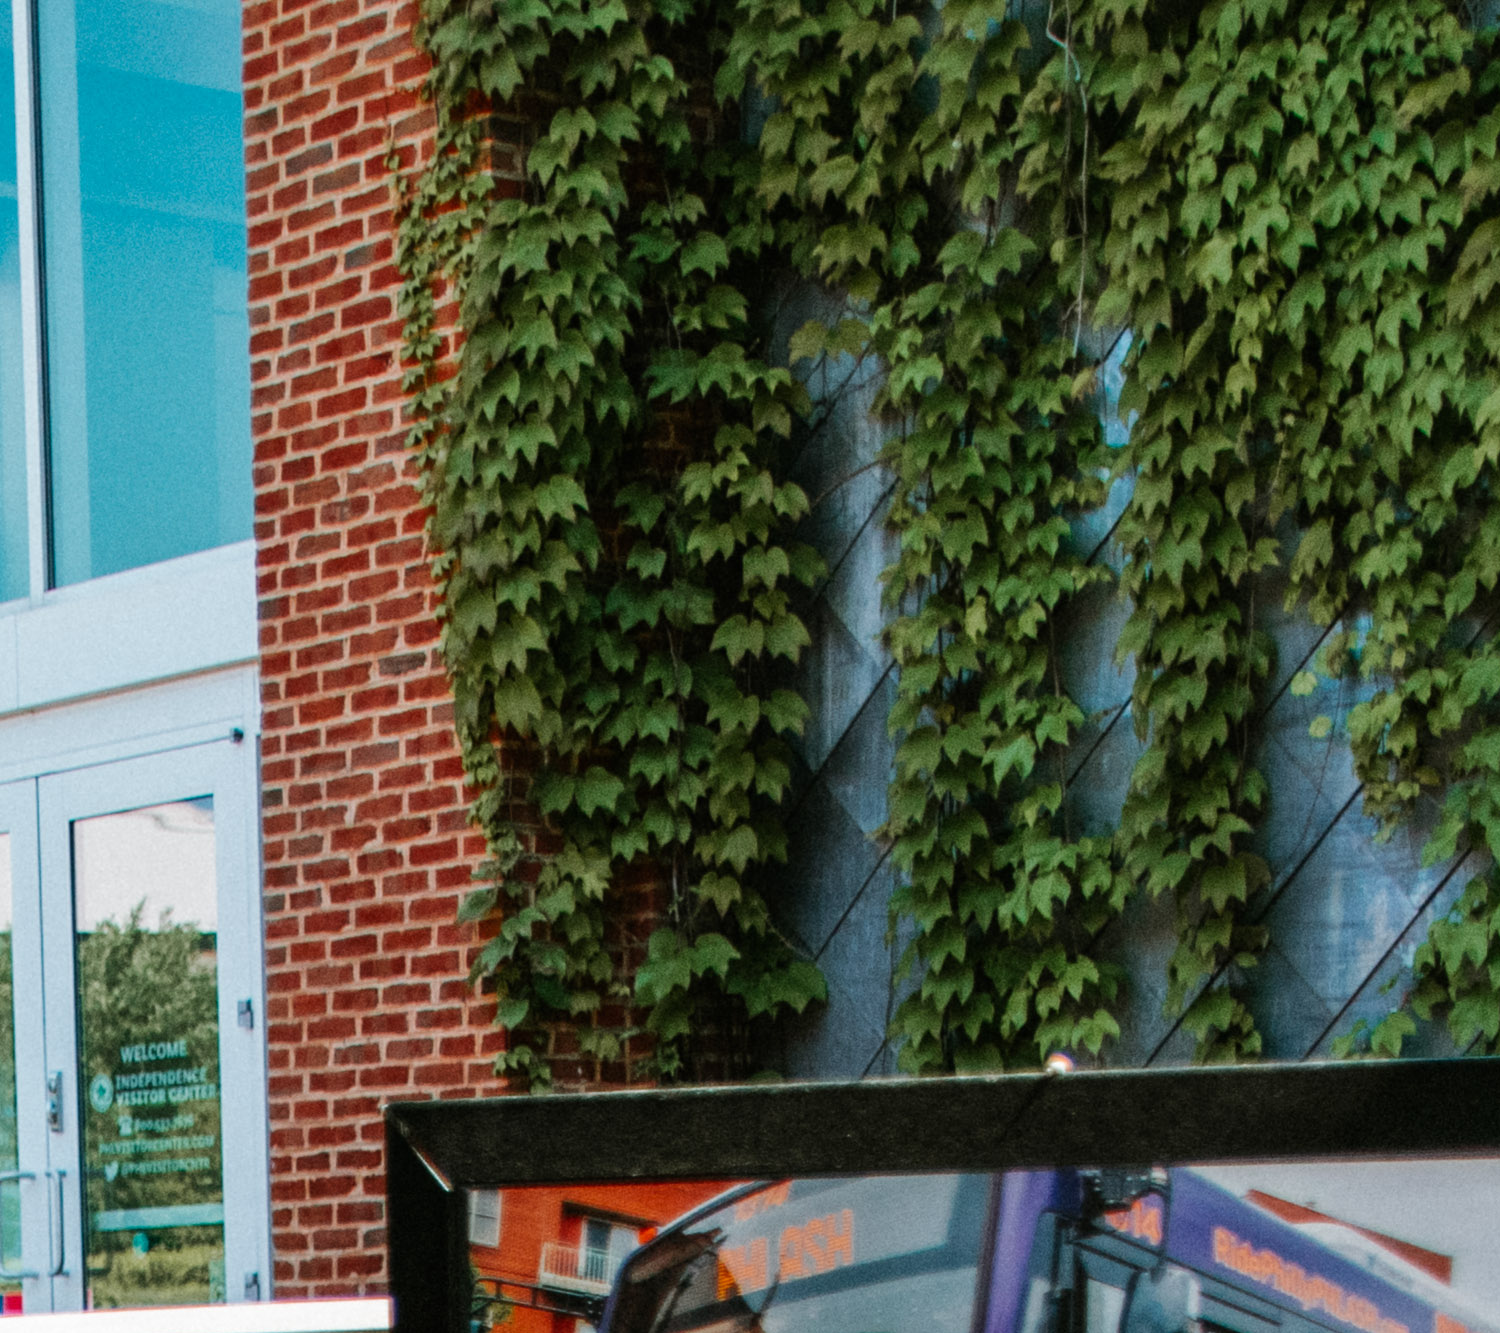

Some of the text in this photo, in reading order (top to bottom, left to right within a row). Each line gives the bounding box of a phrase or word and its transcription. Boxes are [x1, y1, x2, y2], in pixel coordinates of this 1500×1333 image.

[119, 1040, 188, 1064] WELCOME
[115, 1066, 208, 1090] INDEPENDENCE
[116, 1083, 217, 1107] VISITOR CENTER
